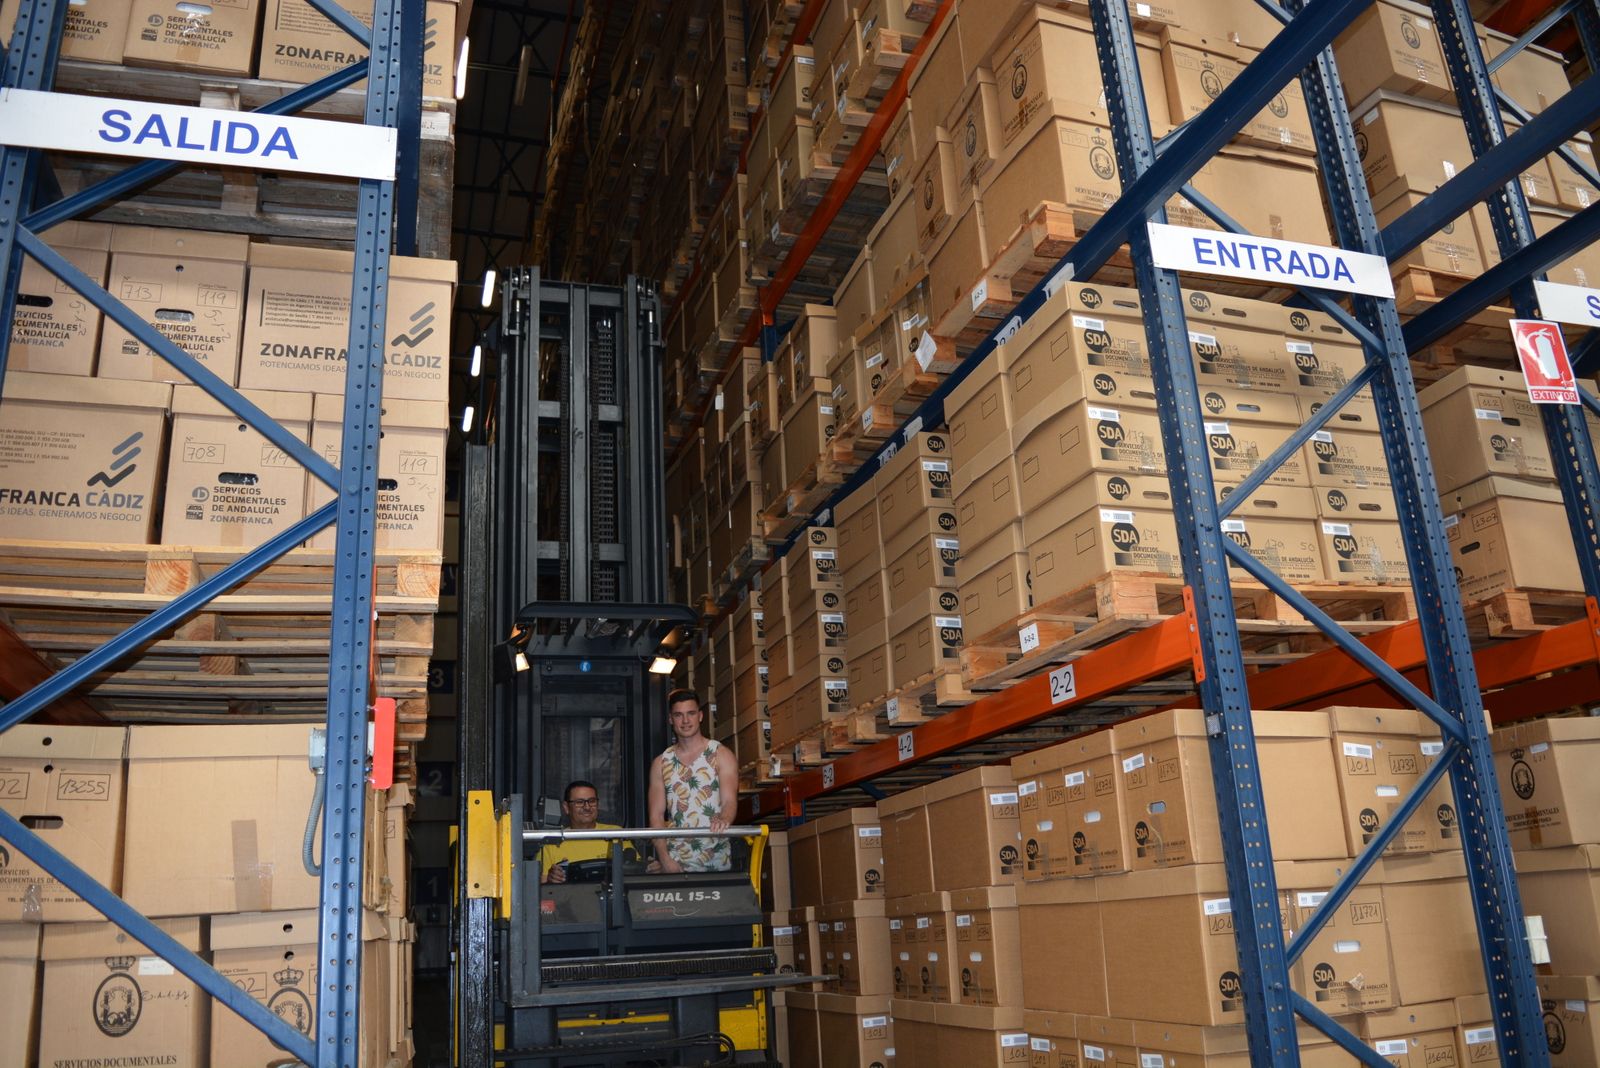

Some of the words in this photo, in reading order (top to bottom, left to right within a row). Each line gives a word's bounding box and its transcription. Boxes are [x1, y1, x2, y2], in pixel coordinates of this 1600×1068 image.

[163, 38, 221, 50] ZONAFRANCA
[275, 44, 369, 65] ZONAFRAN
[423, 64, 442, 76] DIZ
[98, 108, 299, 160] SALIDA
[1192, 237, 1356, 284] ENTRADA
[200, 291, 227, 305] 119
[1081, 292, 1101, 304] SDA
[1191, 296, 1209, 308] SDA
[1587, 295, 1600, 319] S
[15, 310, 53, 320] RVICIOS
[1292, 316, 1309, 327] SDA
[10, 337, 65, 348] NAFRANCA
[1086, 332, 1110, 346] SDA
[178, 341, 214, 352] DALUCÍA
[1198, 344, 1220, 355] SDA
[391, 351, 442, 369] CÁDIZ
[1296, 355, 1318, 368] SDA
[260, 360, 321, 371] POTENCIAMOS
[322, 365, 346, 373] IDEAS
[404, 370, 441, 380] NEGOCIO
[1095, 379, 1115, 390] SDA
[1533, 391, 1577, 401] EXTINTOR
[1206, 398, 1225, 409] SDA
[1099, 426, 1124, 440] SDA
[928, 440, 944, 449] SDA
[1211, 438, 1234, 450] SDA
[1315, 442, 1337, 456] SDA
[1492, 439, 1508, 450] SDA
[188, 446, 217, 460] 708
[401, 457, 428, 472] 119
[931, 472, 950, 483] SDA
[214, 486, 261, 496] SERVICIOS
[1109, 483, 1129, 495] SDA
[0, 489, 81, 507] FRANCA
[86, 490, 144, 509] CÁDIZ
[213, 495, 287, 506] DOCUMENTALES
[1329, 496, 1347, 506] SDA
[212, 504, 225, 512] DE
[227, 505, 280, 514] ANDALUCÍA
[376, 504, 425, 512] MENTALES
[39, 509, 98, 520] GENERAMOS
[100, 512, 142, 522] NEGOCIO
[210, 515, 274, 525] ZONAFRANCA
[377, 512, 419, 521] NDALUCÍA
[376, 522, 414, 531] FRANCA
[939, 516, 955, 528] SDA
[812, 532, 826, 543] SDA
[1113, 529, 1138, 544] SDA
[1334, 538, 1357, 552] SDA
[942, 549, 959, 562] SDA
[817, 559, 834, 570] SDA
[824, 597, 837, 605] SDA
[941, 597, 956, 606] SDA
[826, 624, 843, 633] SDA
[942, 629, 962, 641] SDA
[829, 662, 843, 670] SDA
[430, 668, 445, 688] 3
[1050, 672, 1073, 699] 2-2
[829, 689, 846, 698] SDA
[899, 735, 912, 754] 4-2
[428, 770, 443, 790] 2
[1360, 816, 1378, 826] SDA
[1439, 812, 1455, 821] SDA
[1135, 827, 1148, 838] SDA
[1001, 850, 1017, 860] SDA
[1027, 844, 1038, 854] SDA
[427, 876, 438, 897] 1
[642, 892, 683, 904] DUAL
[688, 891, 721, 901] 15-3
[1315, 970, 1334, 982] SDA
[1221, 979, 1240, 992] SDA
[54, 1058, 102, 1068] SERVICIOS
[104, 1055, 177, 1068] DOCUMENTALES
